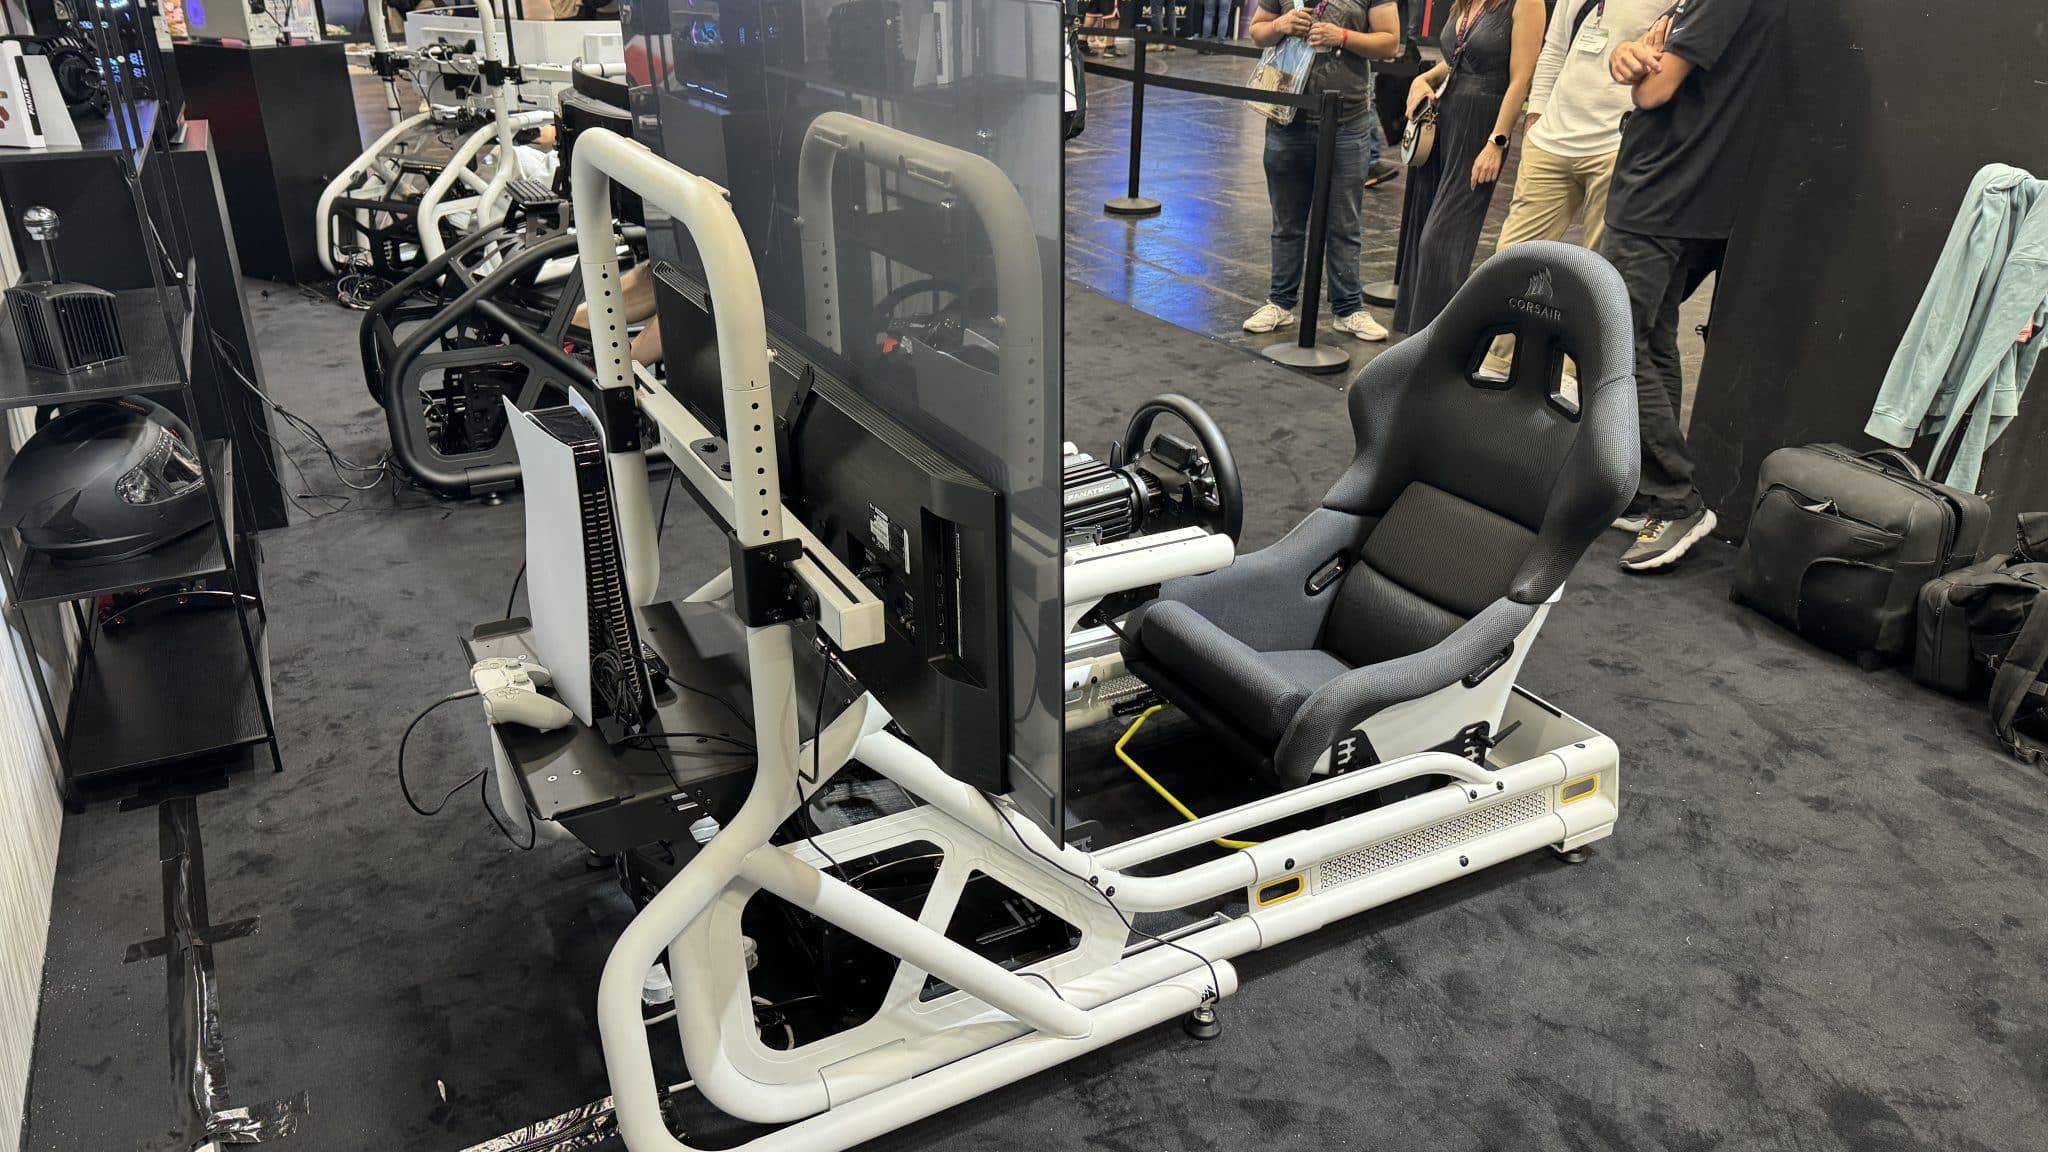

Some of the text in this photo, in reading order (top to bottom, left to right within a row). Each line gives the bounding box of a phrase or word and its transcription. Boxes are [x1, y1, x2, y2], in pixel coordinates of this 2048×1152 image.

[20, 77, 36, 116] FANATEC
[1508, 297, 1561, 321] CORSAIR
[1067, 484, 1111, 502] FANATEC
